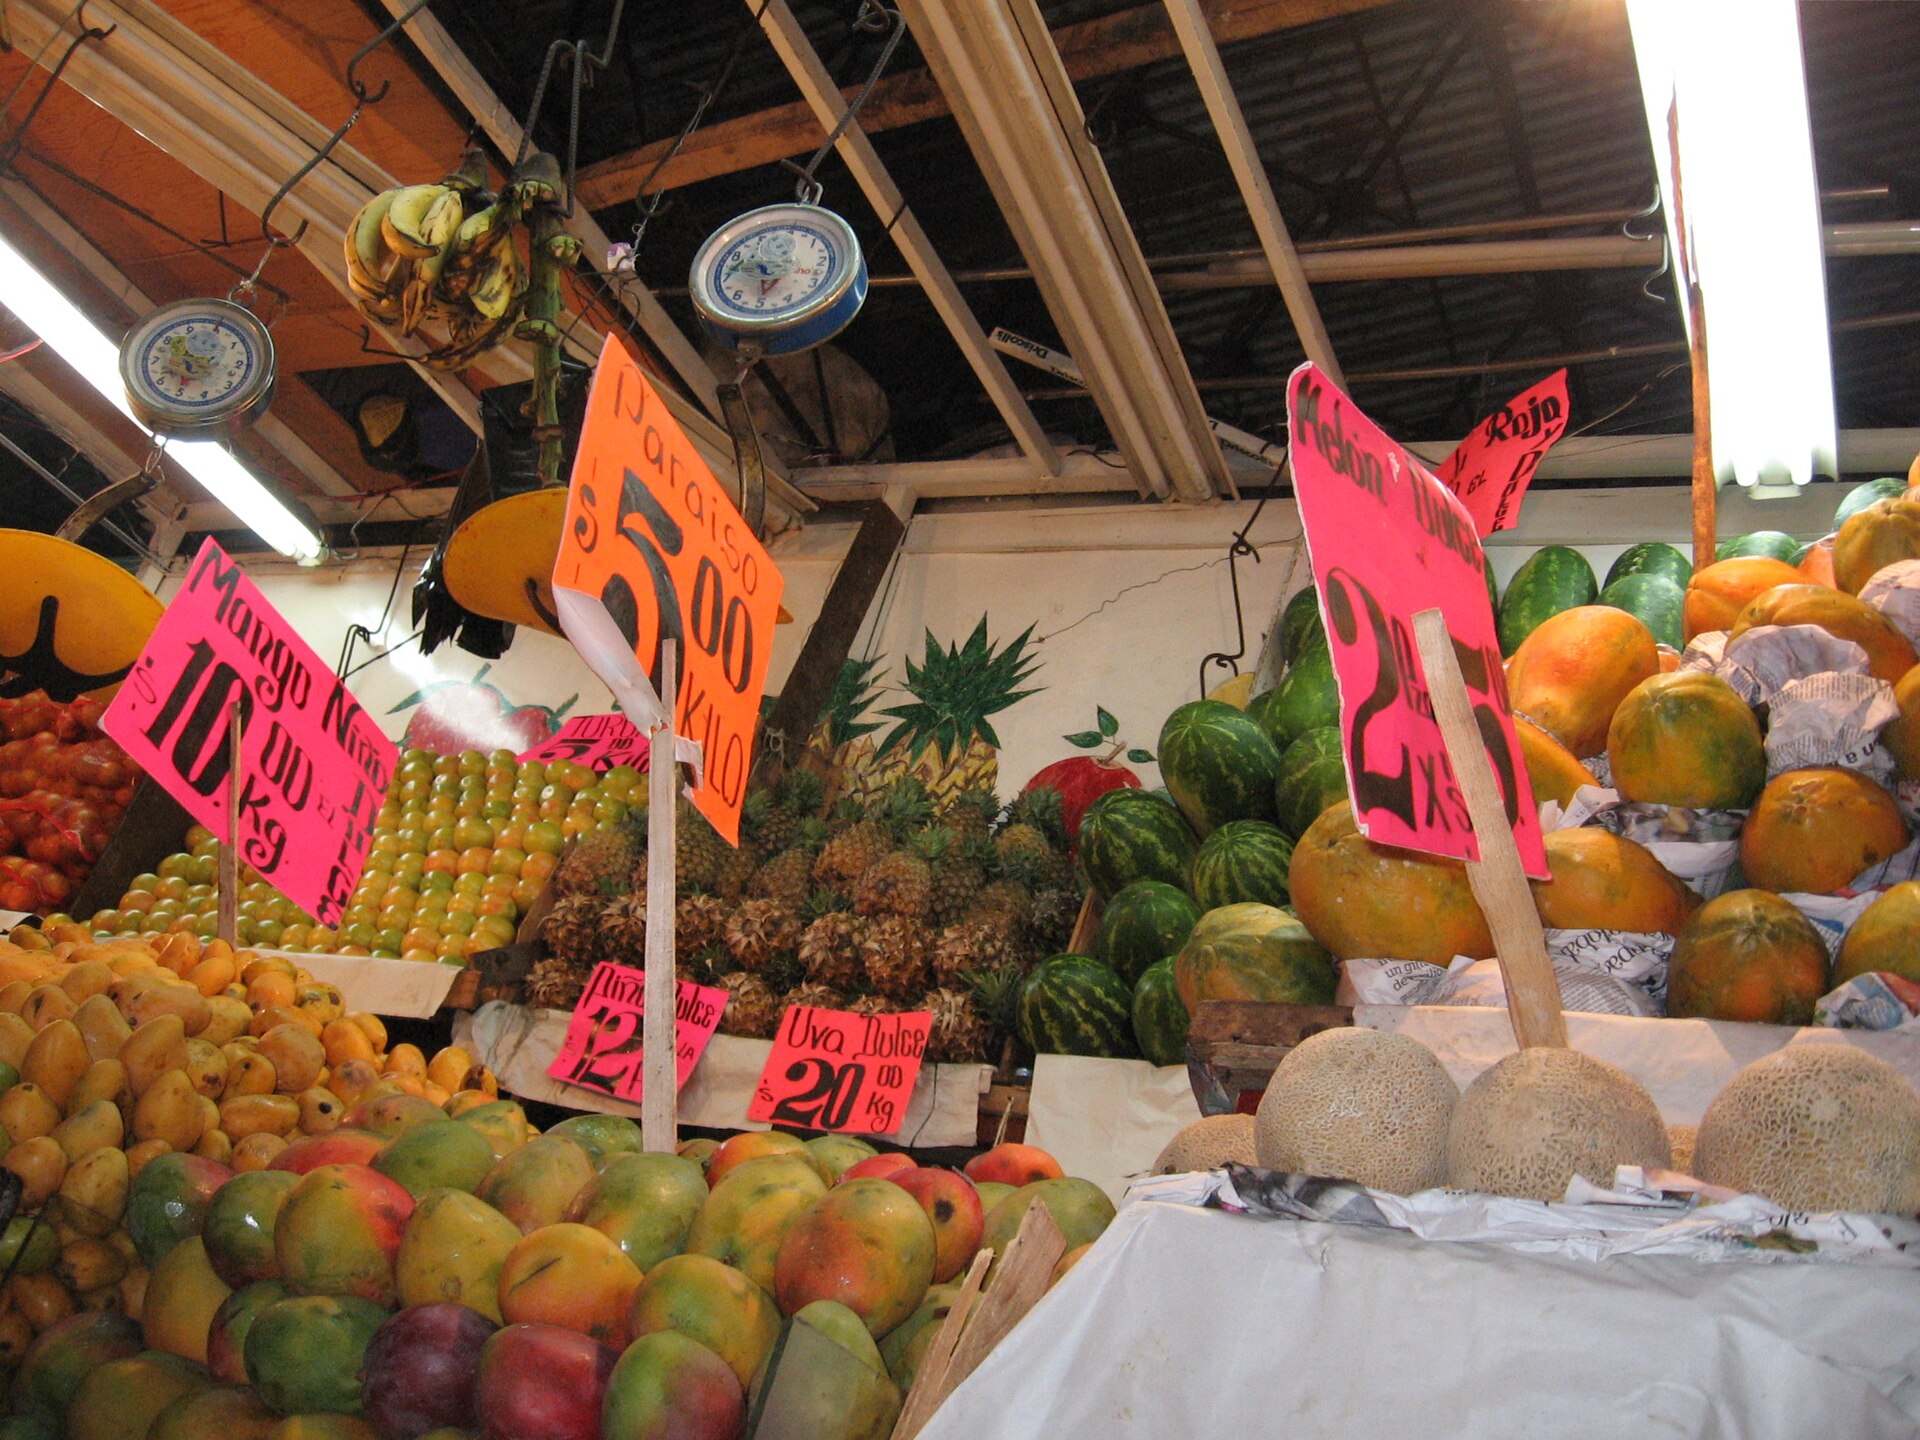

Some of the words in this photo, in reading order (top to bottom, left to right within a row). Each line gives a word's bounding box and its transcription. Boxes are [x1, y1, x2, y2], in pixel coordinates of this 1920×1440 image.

[613, 364, 758, 596] Paraiso
[189, 545, 312, 713] Mango
[690, 554, 753, 695] 00
[259, 720, 314, 812] 00
[787, 1007, 845, 1055] Uva
[852, 1013, 926, 1060] Dulce
[876, 1064, 903, 1089] 00
